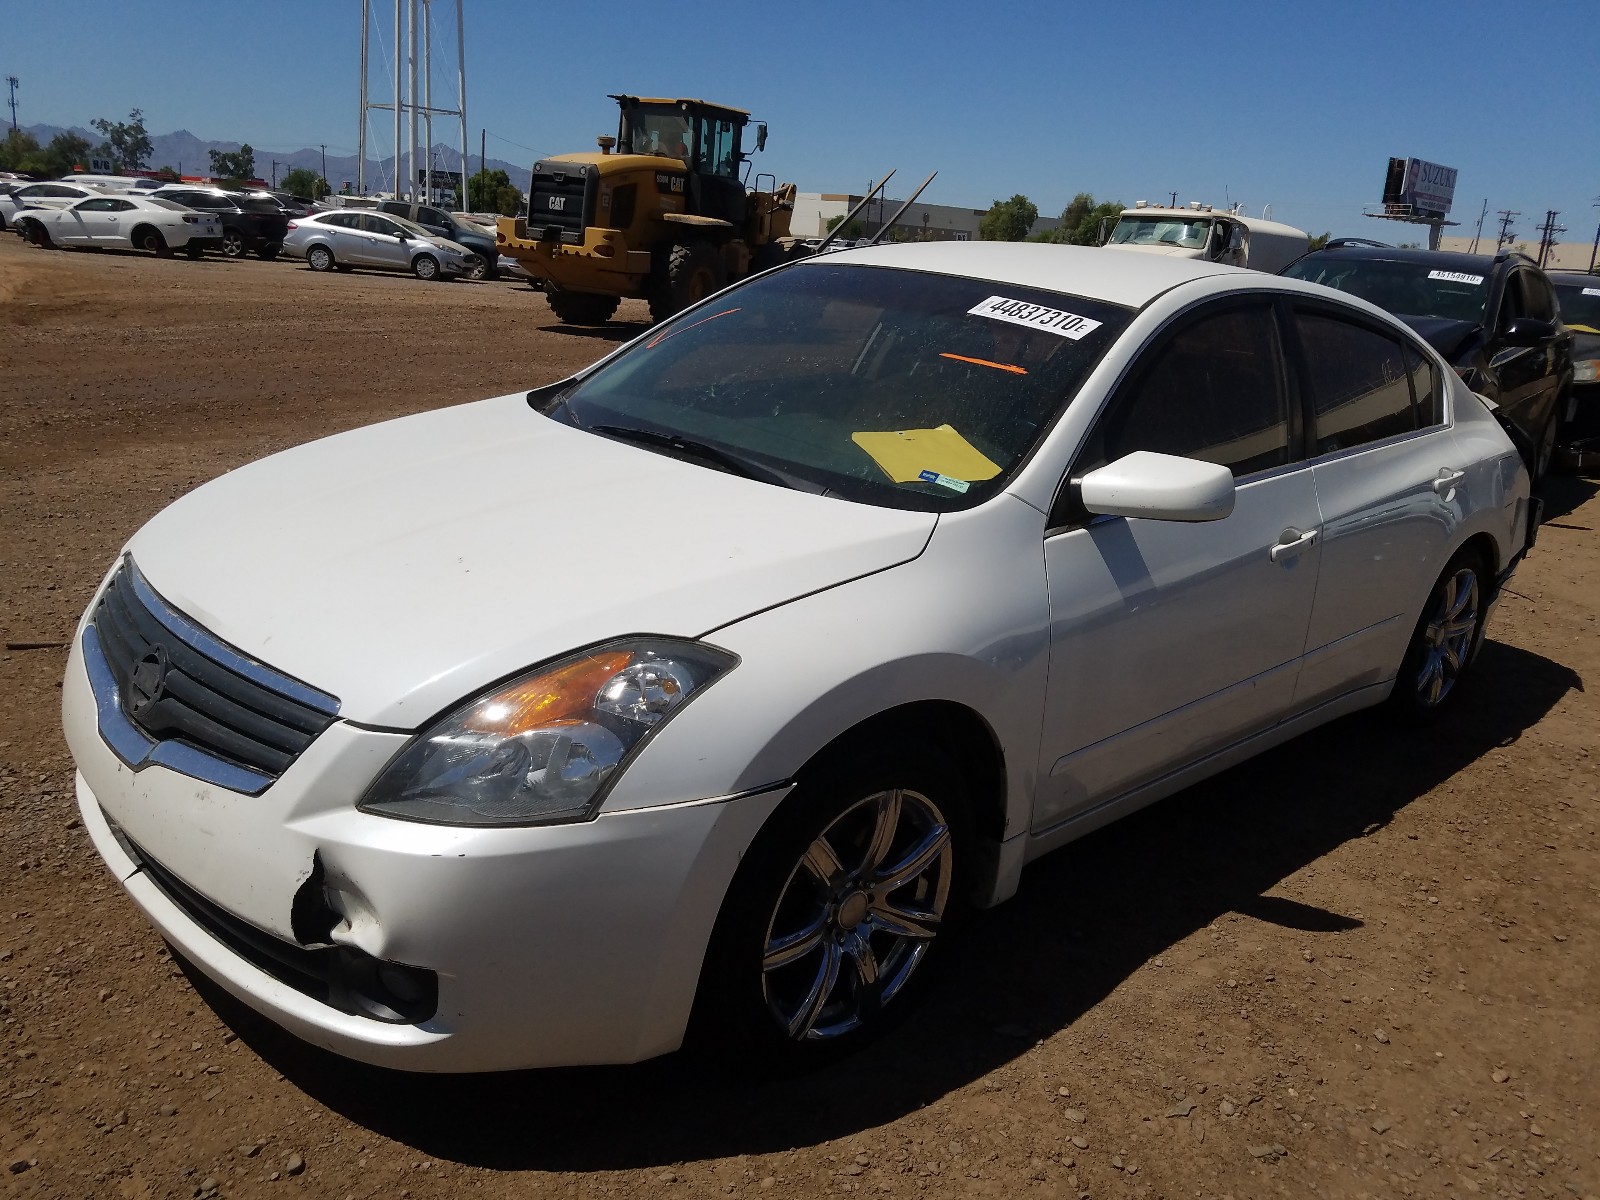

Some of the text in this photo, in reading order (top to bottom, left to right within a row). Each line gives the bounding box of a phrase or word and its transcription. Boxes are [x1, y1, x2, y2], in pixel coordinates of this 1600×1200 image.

[1421, 161, 1458, 189] SUZUKI
[670, 176, 685, 193] CAT
[548, 196, 566, 211] CAT
